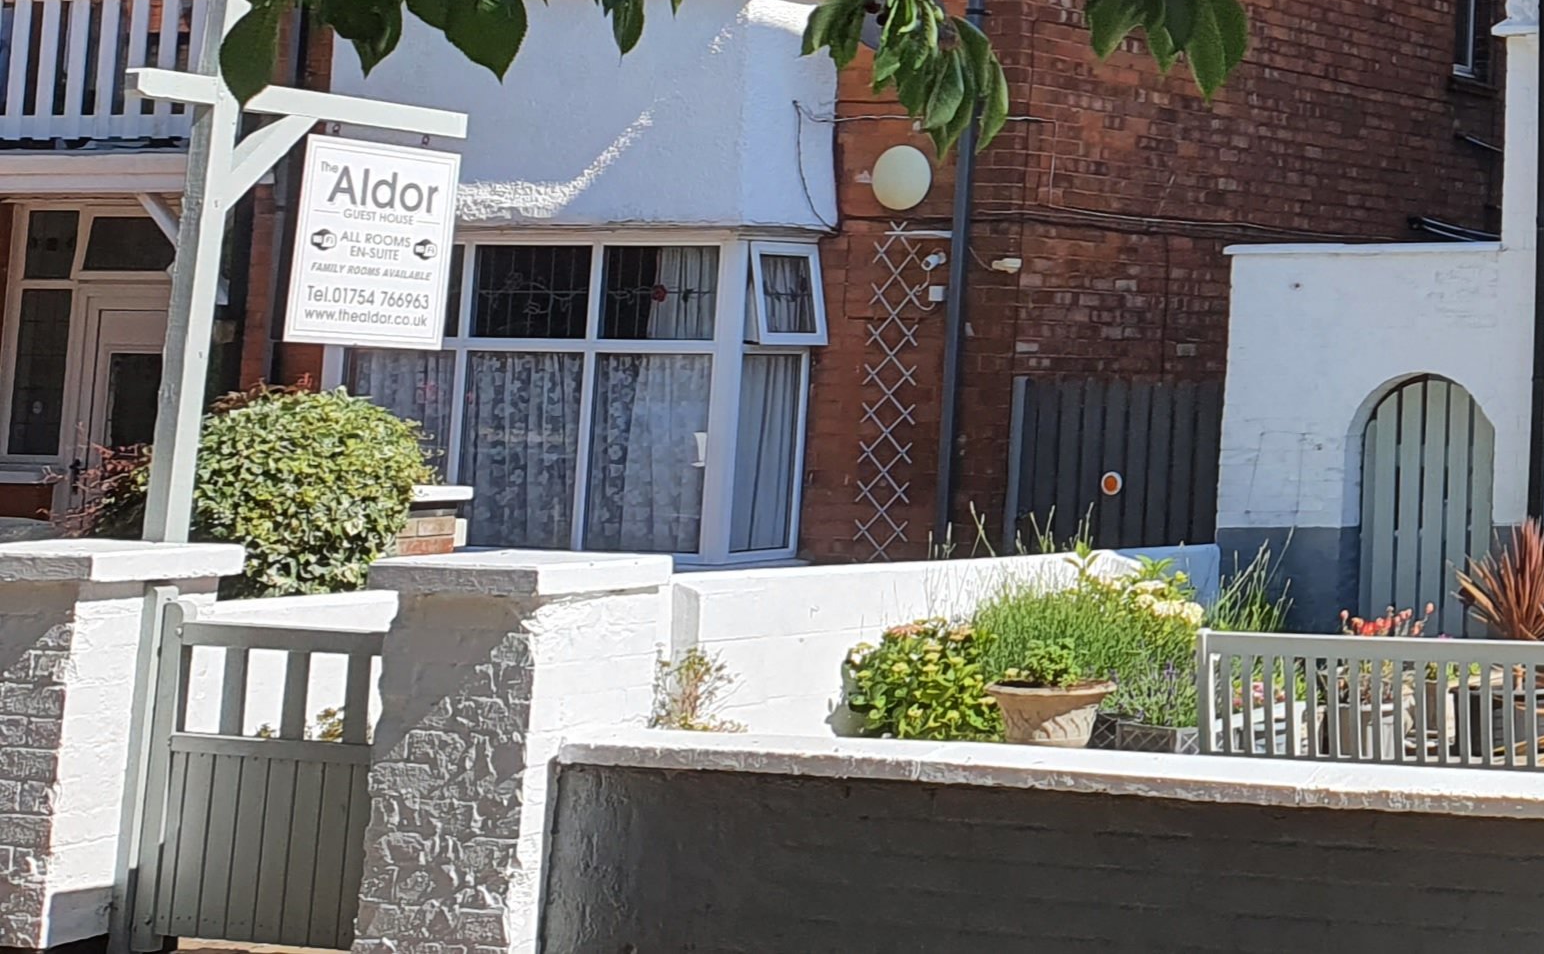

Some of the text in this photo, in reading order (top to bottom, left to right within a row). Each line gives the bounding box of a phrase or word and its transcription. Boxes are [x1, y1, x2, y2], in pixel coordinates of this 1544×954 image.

[321, 161, 438, 213] The Aldor
[343, 208, 414, 225] GUEST HOUSE
[340, 231, 361, 243] ALL
[365, 233, 411, 248] ROOMS
[350, 246, 400, 261] EN-SUITE
[310, 262, 432, 281] FAMILY ROOMS AVAILABLE
[307, 285, 429, 309] Tel.01754 766963
[304, 308, 428, 327] www.thealdor.co.uk
